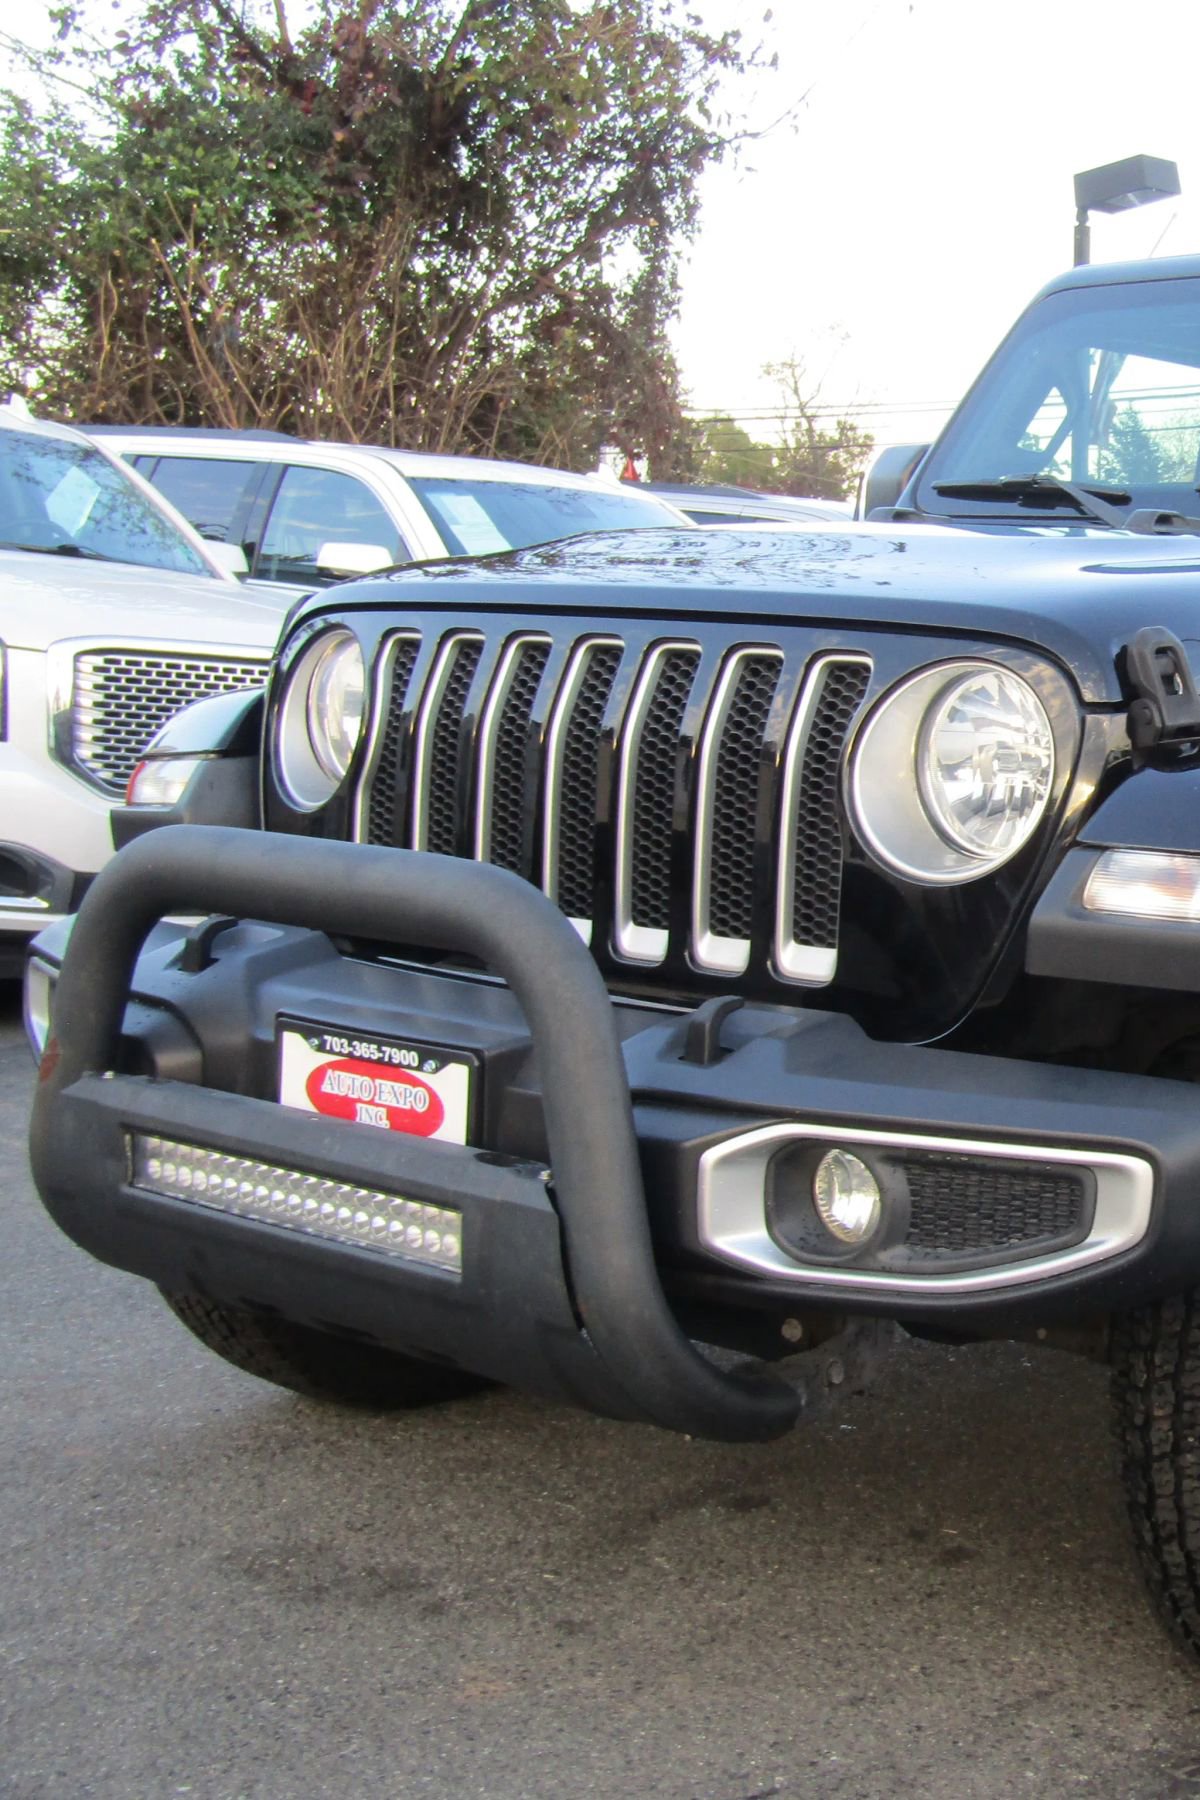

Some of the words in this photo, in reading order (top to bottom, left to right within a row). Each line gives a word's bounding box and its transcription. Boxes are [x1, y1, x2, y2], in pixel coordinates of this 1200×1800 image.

[323, 1034, 419, 1067] 703-365-7900
[322, 1069, 373, 1101] AUTO
[373, 1079, 430, 1112] EXPO
[355, 1104, 391, 1129] INC.
